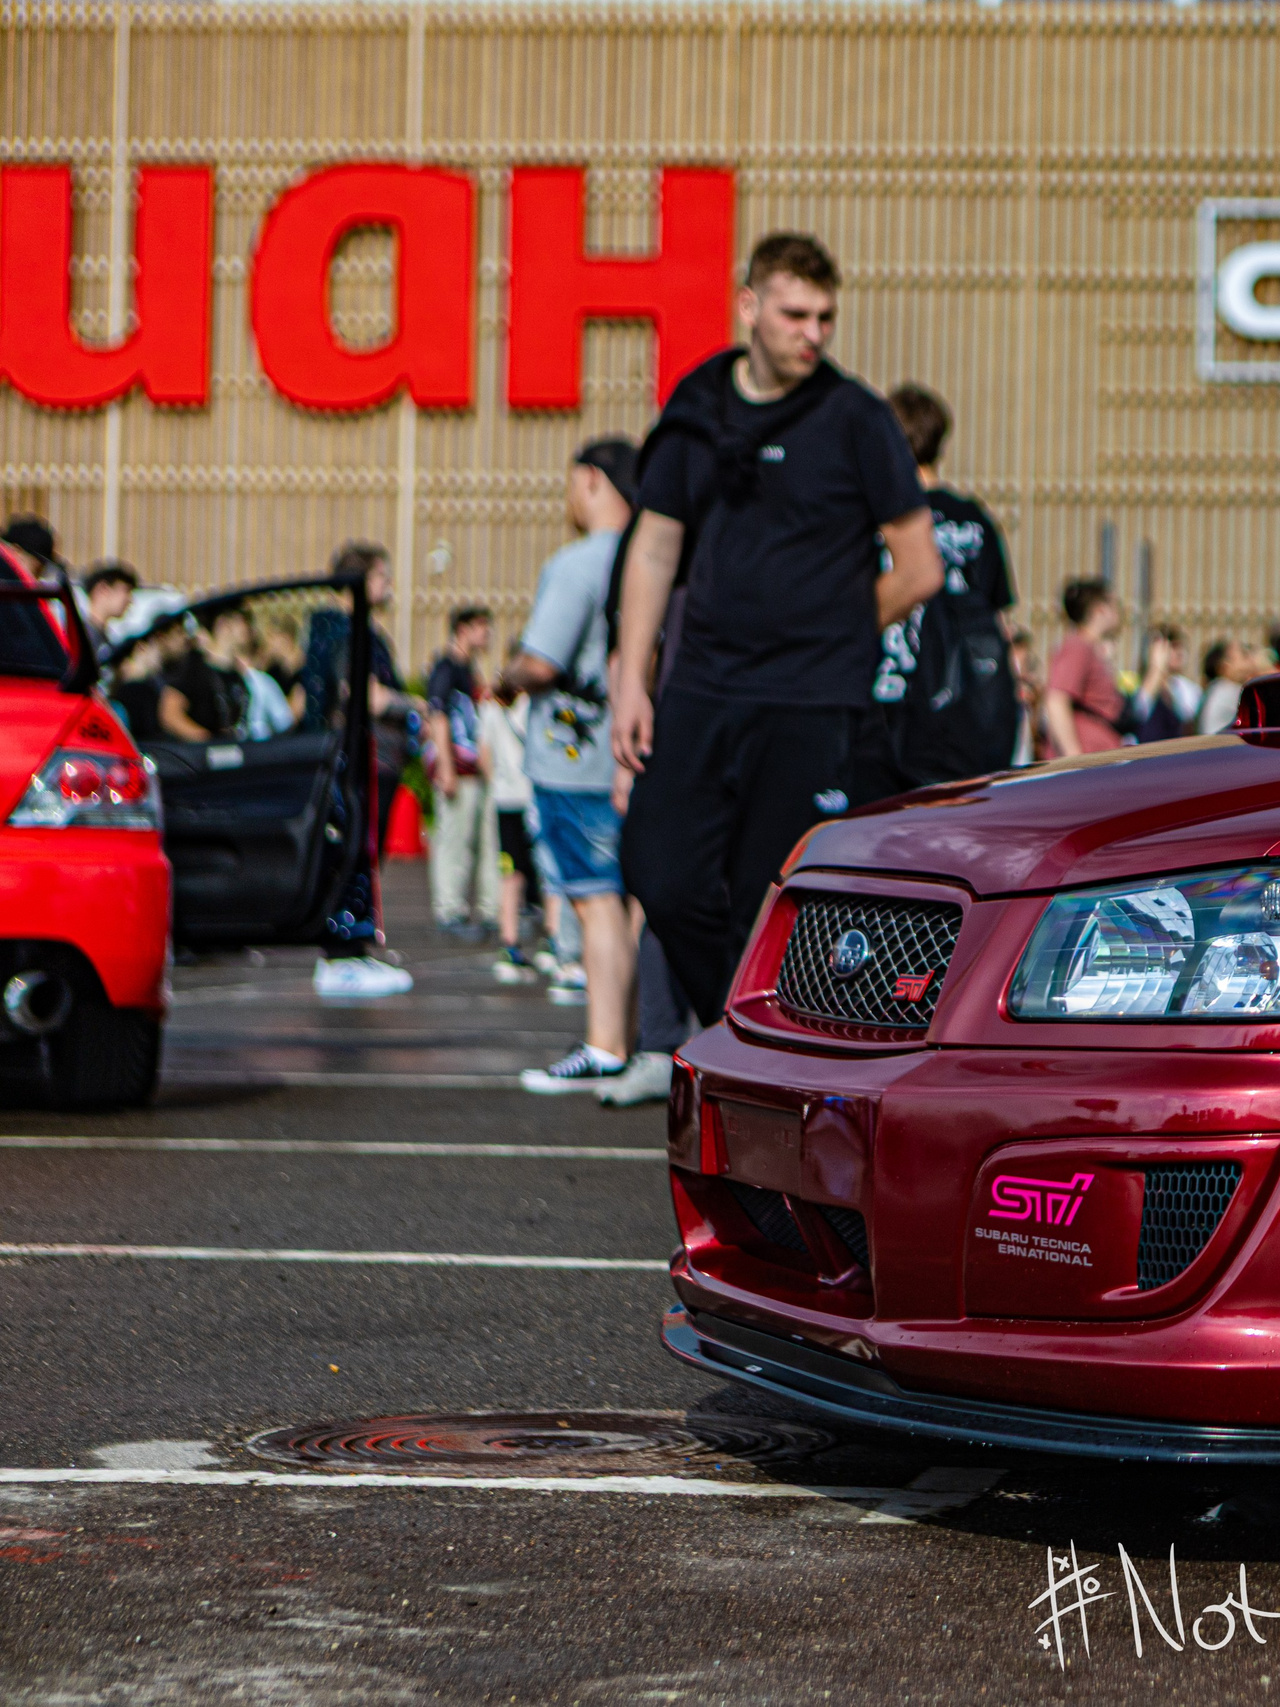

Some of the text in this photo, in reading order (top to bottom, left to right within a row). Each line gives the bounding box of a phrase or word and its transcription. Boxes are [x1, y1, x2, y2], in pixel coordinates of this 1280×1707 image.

[975, 1227, 1092, 1254] SUBARU TECNICA
[998, 1243, 1093, 1267] ERNATIONAL
